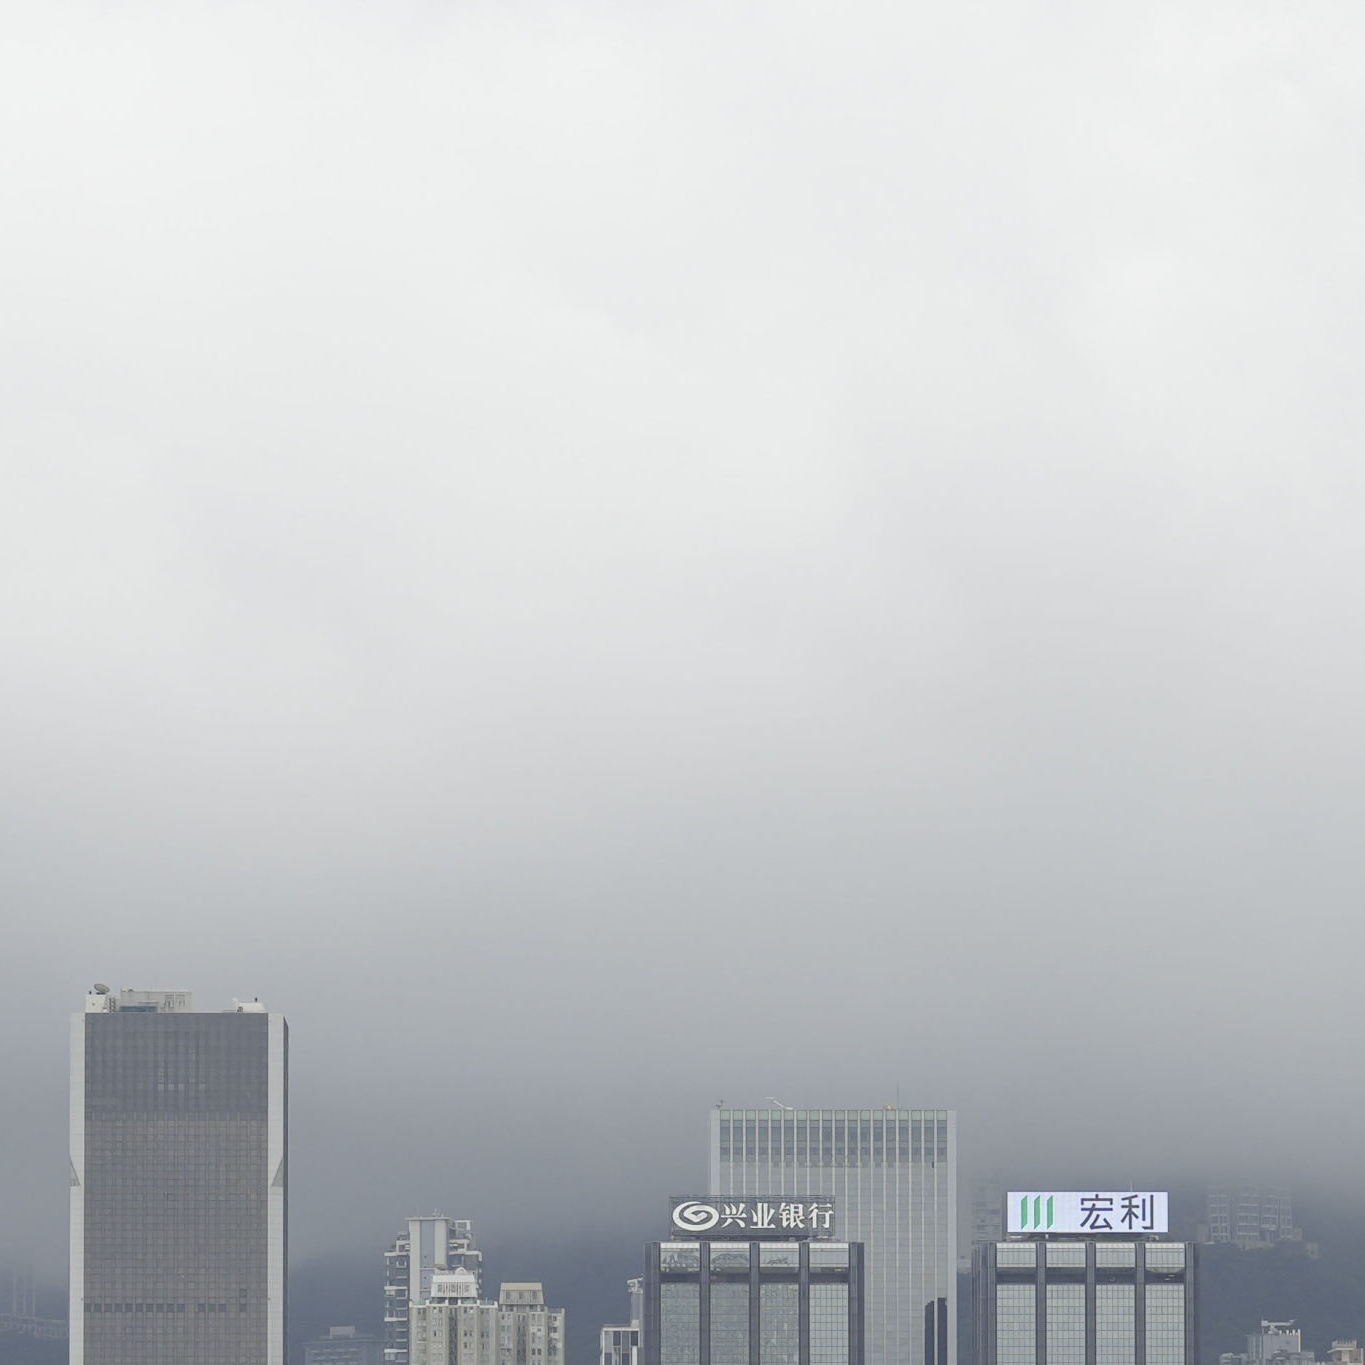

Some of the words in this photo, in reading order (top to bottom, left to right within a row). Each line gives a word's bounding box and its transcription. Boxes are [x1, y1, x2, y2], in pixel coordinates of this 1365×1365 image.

[720, 1202, 834, 1230] 兴业银行
[1079, 1193, 1155, 1231] 宏利
